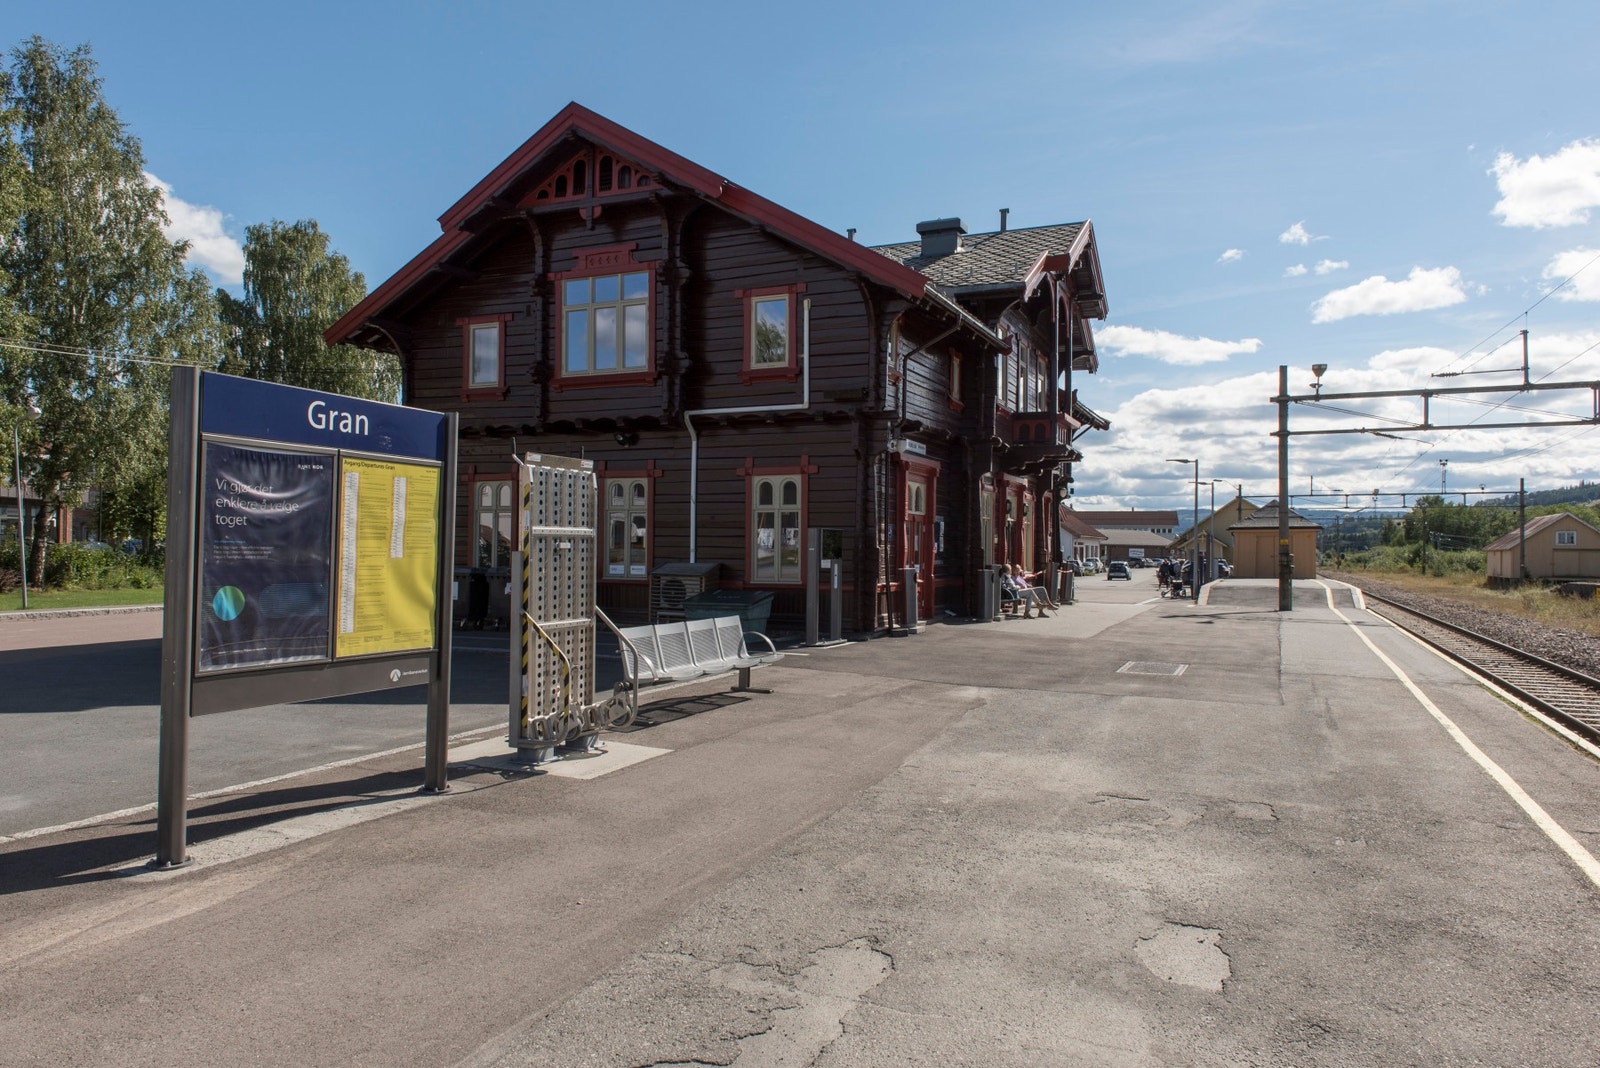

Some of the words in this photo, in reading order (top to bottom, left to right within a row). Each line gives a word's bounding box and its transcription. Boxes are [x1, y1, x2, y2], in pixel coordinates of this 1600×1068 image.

[307, 400, 369, 436] Gran
[215, 478, 227, 490] Vi
[254, 483, 273, 494] det
[215, 497, 258, 511] enklere
[260, 498, 267, 511] å
[270, 501, 300, 514] velge
[215, 514, 248, 528] toget
